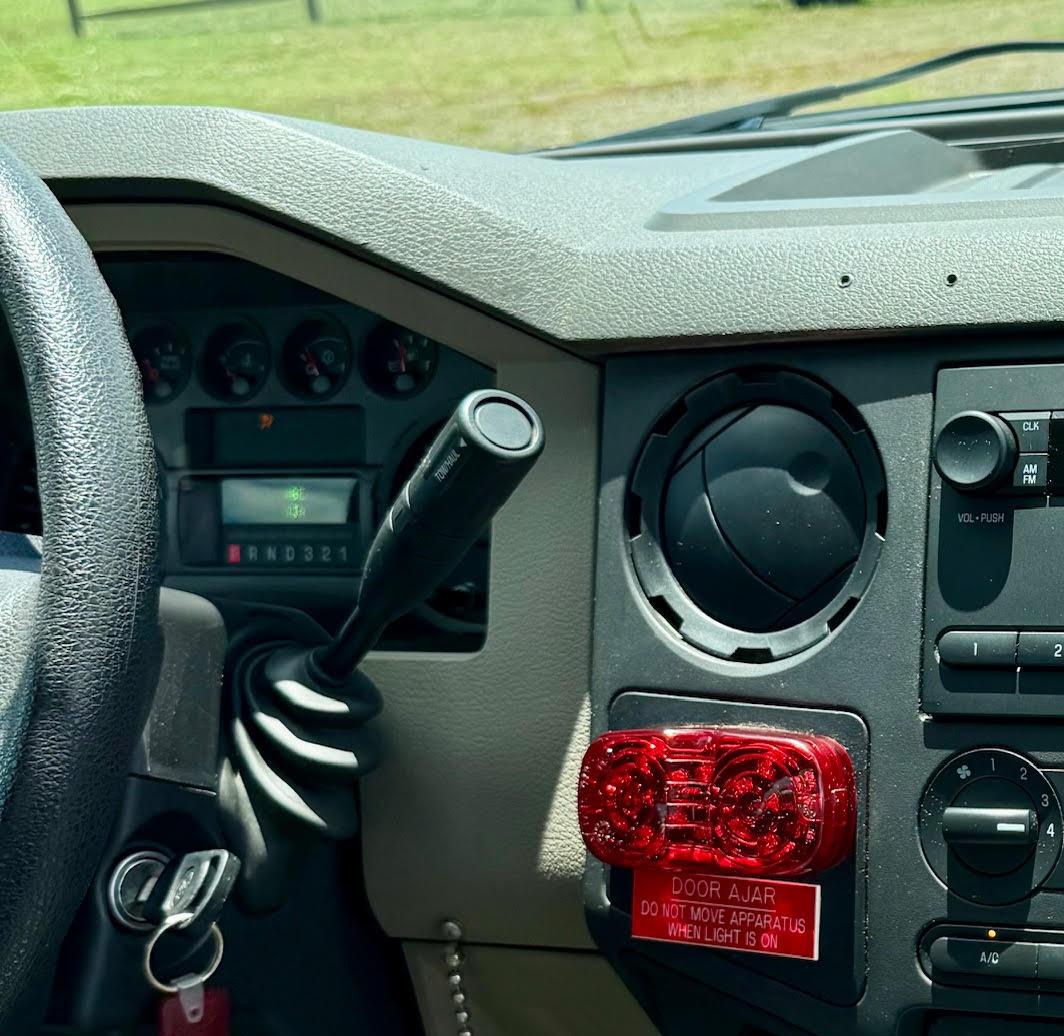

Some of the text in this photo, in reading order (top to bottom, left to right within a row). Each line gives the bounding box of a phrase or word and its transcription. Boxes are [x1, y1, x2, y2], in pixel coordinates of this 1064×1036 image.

[1022, 421, 1040, 431] CLK
[1023, 464, 1038, 474] AM
[1023, 475, 1037, 484] FM
[1054, 643, 1062, 657] 2
[1020, 767, 1028, 780] 2
[1041, 794, 1049, 807] 3
[1046, 823, 1055, 837] 4
[672, 876, 776, 905] DOOR AJAR
[641, 900, 806, 934] DO NOT MOVE APPARATUS
[668, 922, 778, 948] WHEN LIGHT IS ON
[980, 951, 999, 964] A/C
